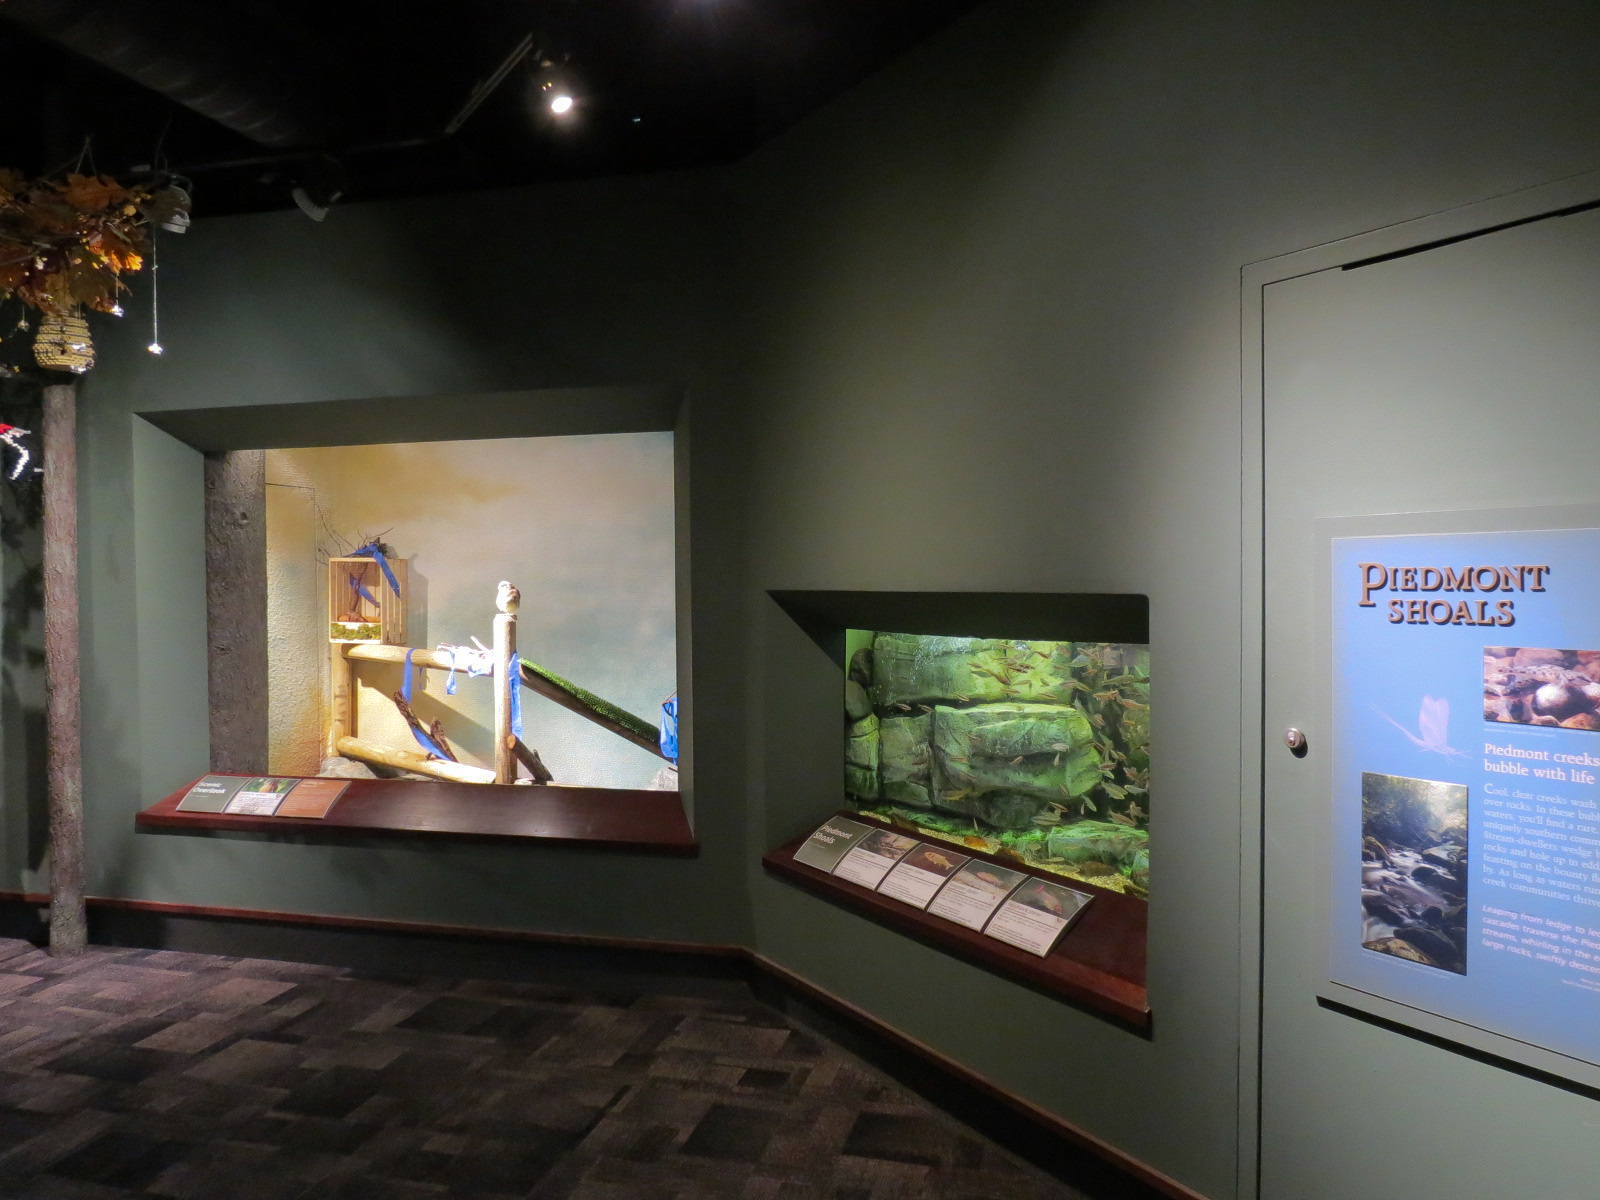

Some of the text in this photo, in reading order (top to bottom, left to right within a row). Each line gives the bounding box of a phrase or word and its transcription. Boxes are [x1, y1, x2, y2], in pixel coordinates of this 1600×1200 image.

[1357, 562, 1550, 608] PIEDMONT
[1387, 599, 1515, 627] SHOALS
[1484, 743, 1600, 767] Piedmont creeks
[1484, 759, 1596, 784] bubble with life
[1484, 798, 1503, 806] over
[1536, 804, 1546, 814] In
[1550, 806, 1575, 818] these
[1536, 795, 1567, 804] creeks
[1570, 799, 1596, 809] wash
[1546, 816, 1565, 828] find
[813, 832, 836, 844] Shoals
[820, 826, 854, 840] Piedmont
[1524, 828, 1567, 840] southern
[1484, 844, 1508, 854] rocks
[1510, 848, 1526, 857] and
[1560, 846, 1592, 858] wedge
[1512, 870, 1533, 884] long
[1536, 876, 1546, 884] as
[1549, 880, 1580, 890] waters
[1520, 862, 1532, 870] on
[1536, 862, 1551, 874] the
[1554, 866, 1588, 882] bounty
[1510, 882, 1570, 900] communities
[1482, 904, 1518, 920] Leaping
[1520, 912, 1543, 924] from
[1546, 918, 1572, 931] ledge
[1576, 926, 1585, 934] to
[1482, 917, 1520, 931] cascades
[1522, 926, 1560, 940] traverse
[1562, 934, 1578, 944] the
[1482, 937, 1505, 950] large
[1574, 950, 1591, 960] the
